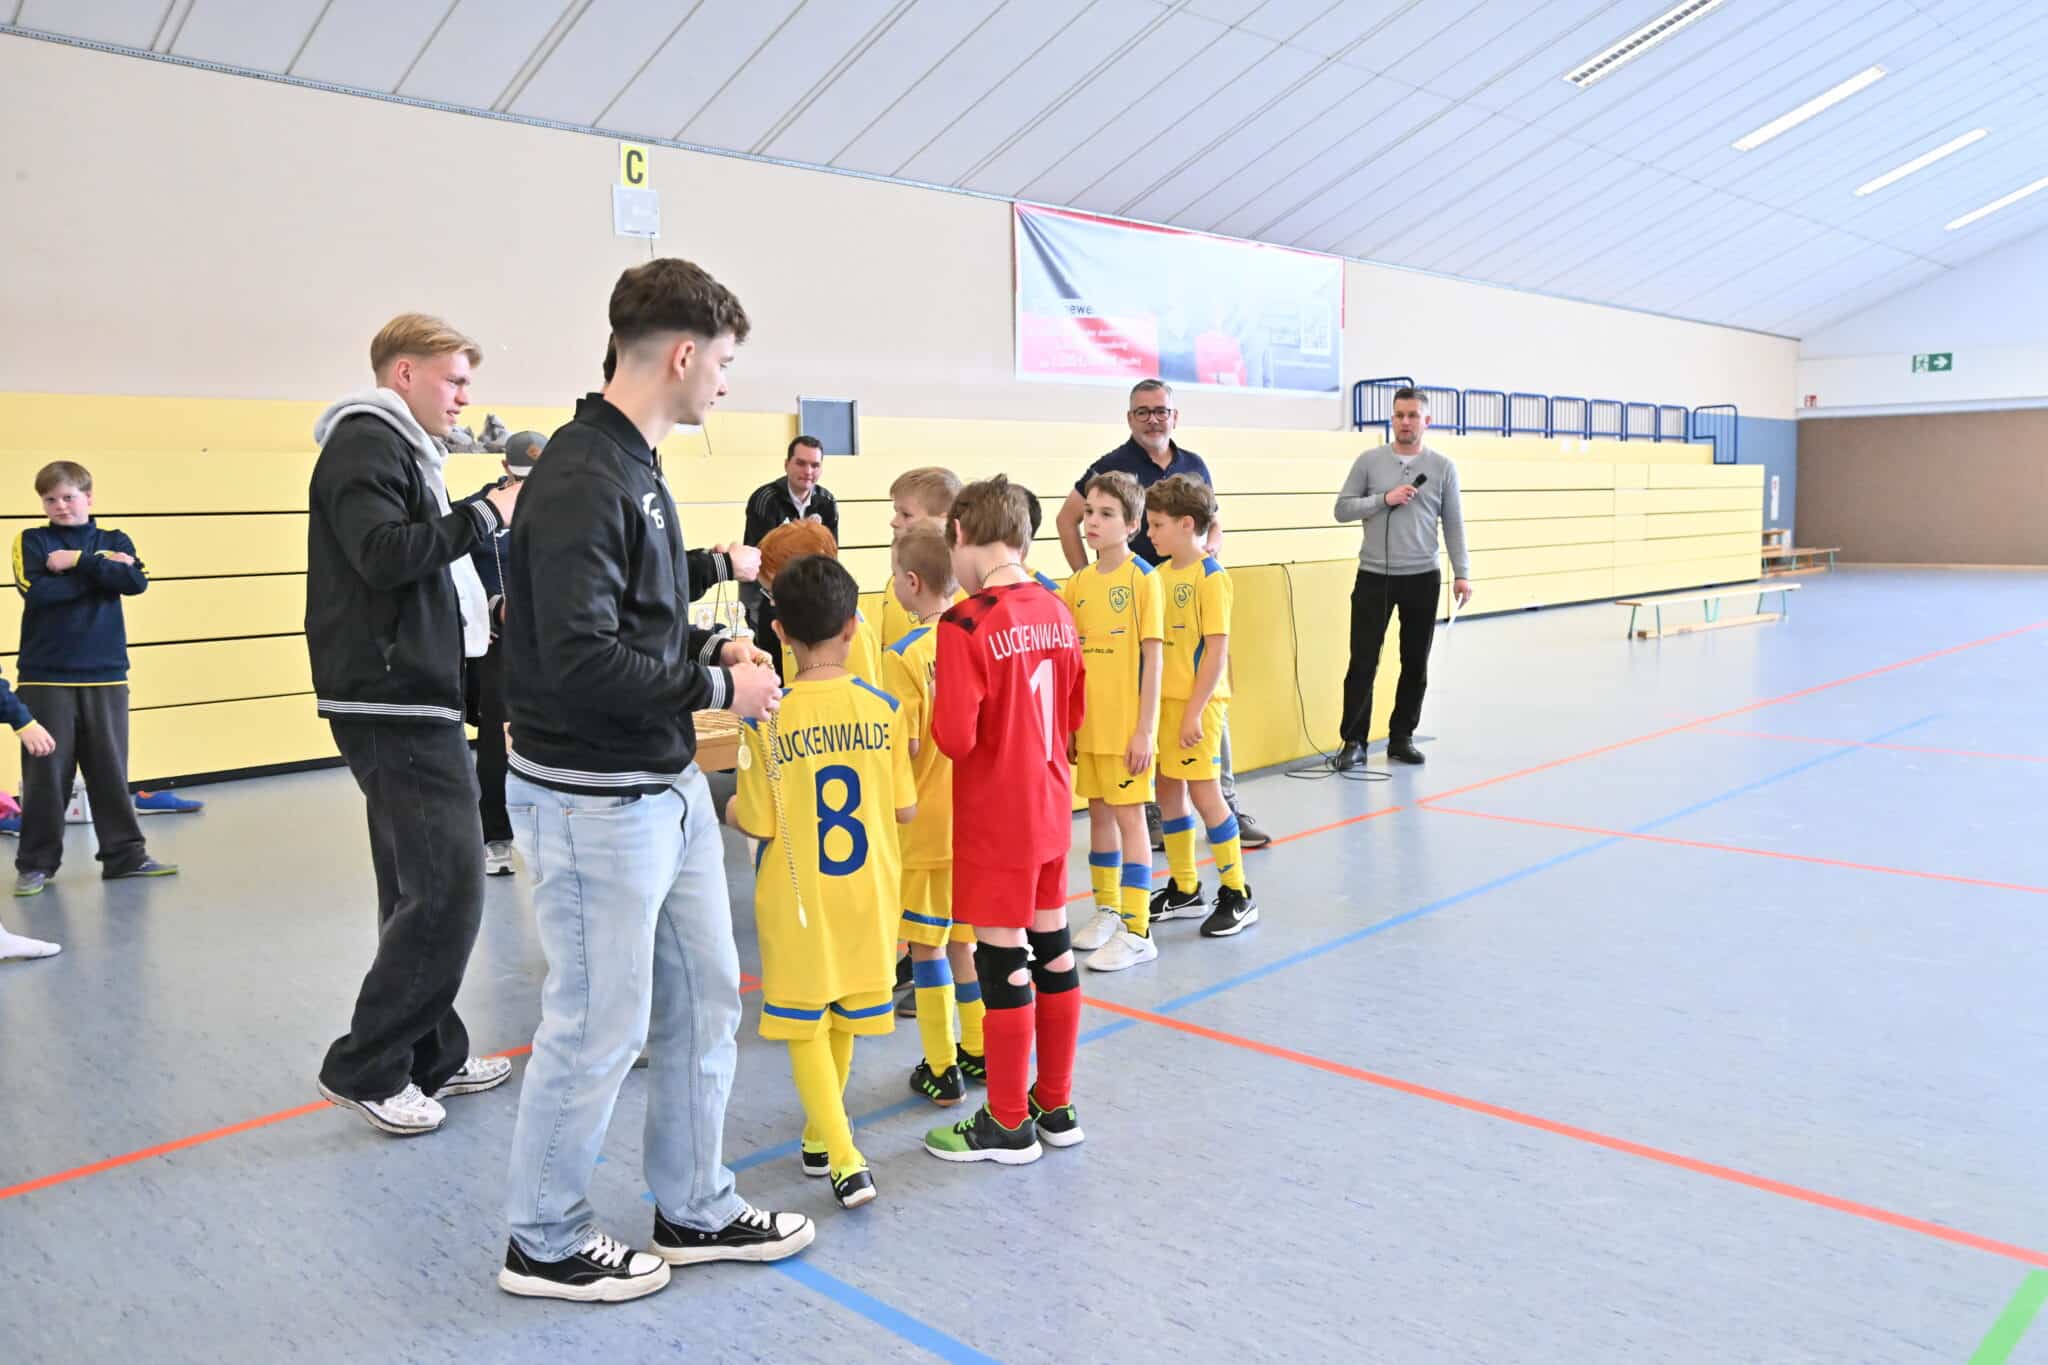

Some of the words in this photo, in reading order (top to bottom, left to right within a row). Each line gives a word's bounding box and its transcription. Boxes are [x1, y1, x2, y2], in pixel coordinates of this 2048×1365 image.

[626, 149, 643, 184] C
[1030, 658, 1053, 762] 1
[815, 764, 869, 877] 8
